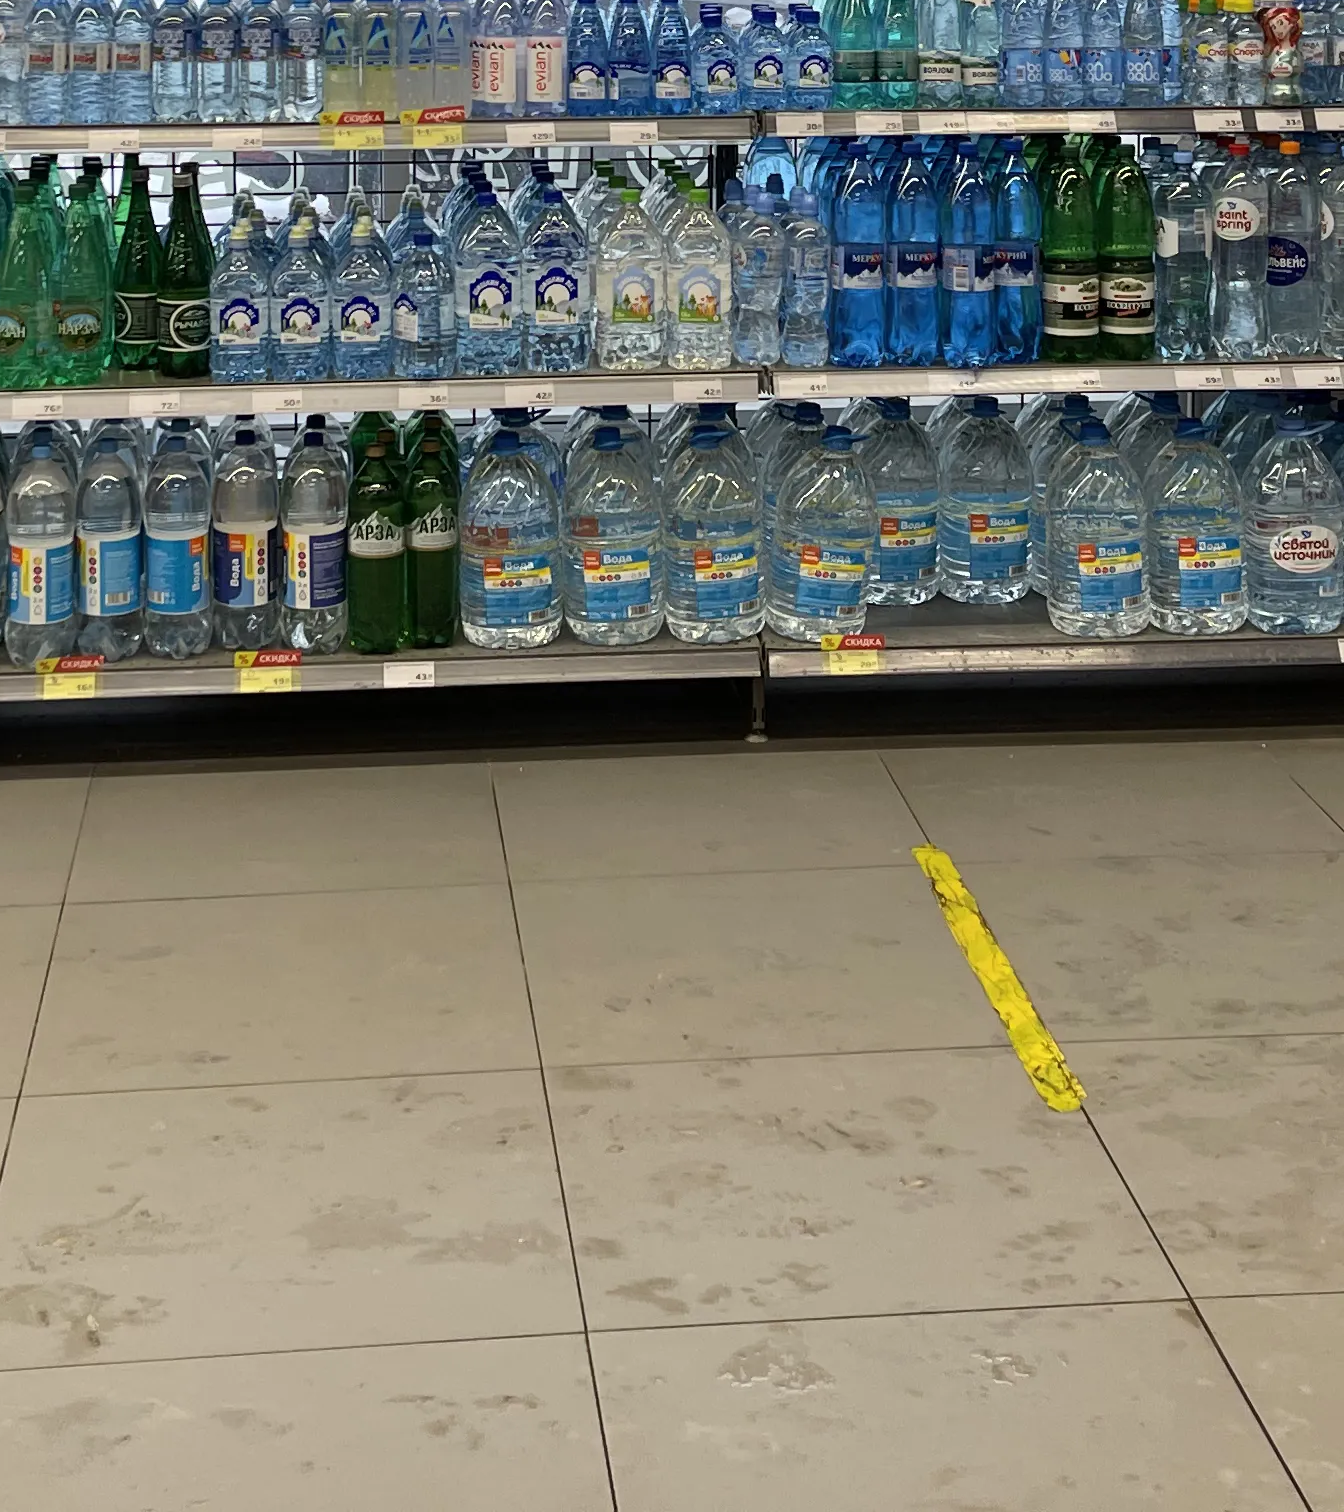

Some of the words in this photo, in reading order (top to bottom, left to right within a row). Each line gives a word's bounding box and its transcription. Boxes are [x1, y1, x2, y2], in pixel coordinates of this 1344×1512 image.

[489, 51, 500, 91] evian
[536, 50, 547, 91] evian
[972, 70, 998, 78] BORJOM
[343, 112, 382, 123] СКИДКА
[1218, 209, 1249, 220] saint
[1216, 219, 1252, 232] spring
[851, 254, 882, 264] МЕРКУ
[904, 252, 936, 262] МЕРКУ
[1267, 255, 1307, 270] ЛЬВЕЙС
[419, 517, 455, 533] АРЗА
[900, 521, 926, 530] Вода
[990, 517, 1016, 526] Вода
[356, 527, 395, 539] АРЗА
[1282, 539, 1330, 550] святой
[603, 554, 633, 564] Вода
[1274, 550, 1336, 561] источник
[190, 560, 202, 593] Вода
[229, 558, 241, 587] Вода
[844, 636, 882, 648] СКИДКА
[60, 656, 103, 669] СКИДКА
[259, 653, 299, 665] СКИДКА
